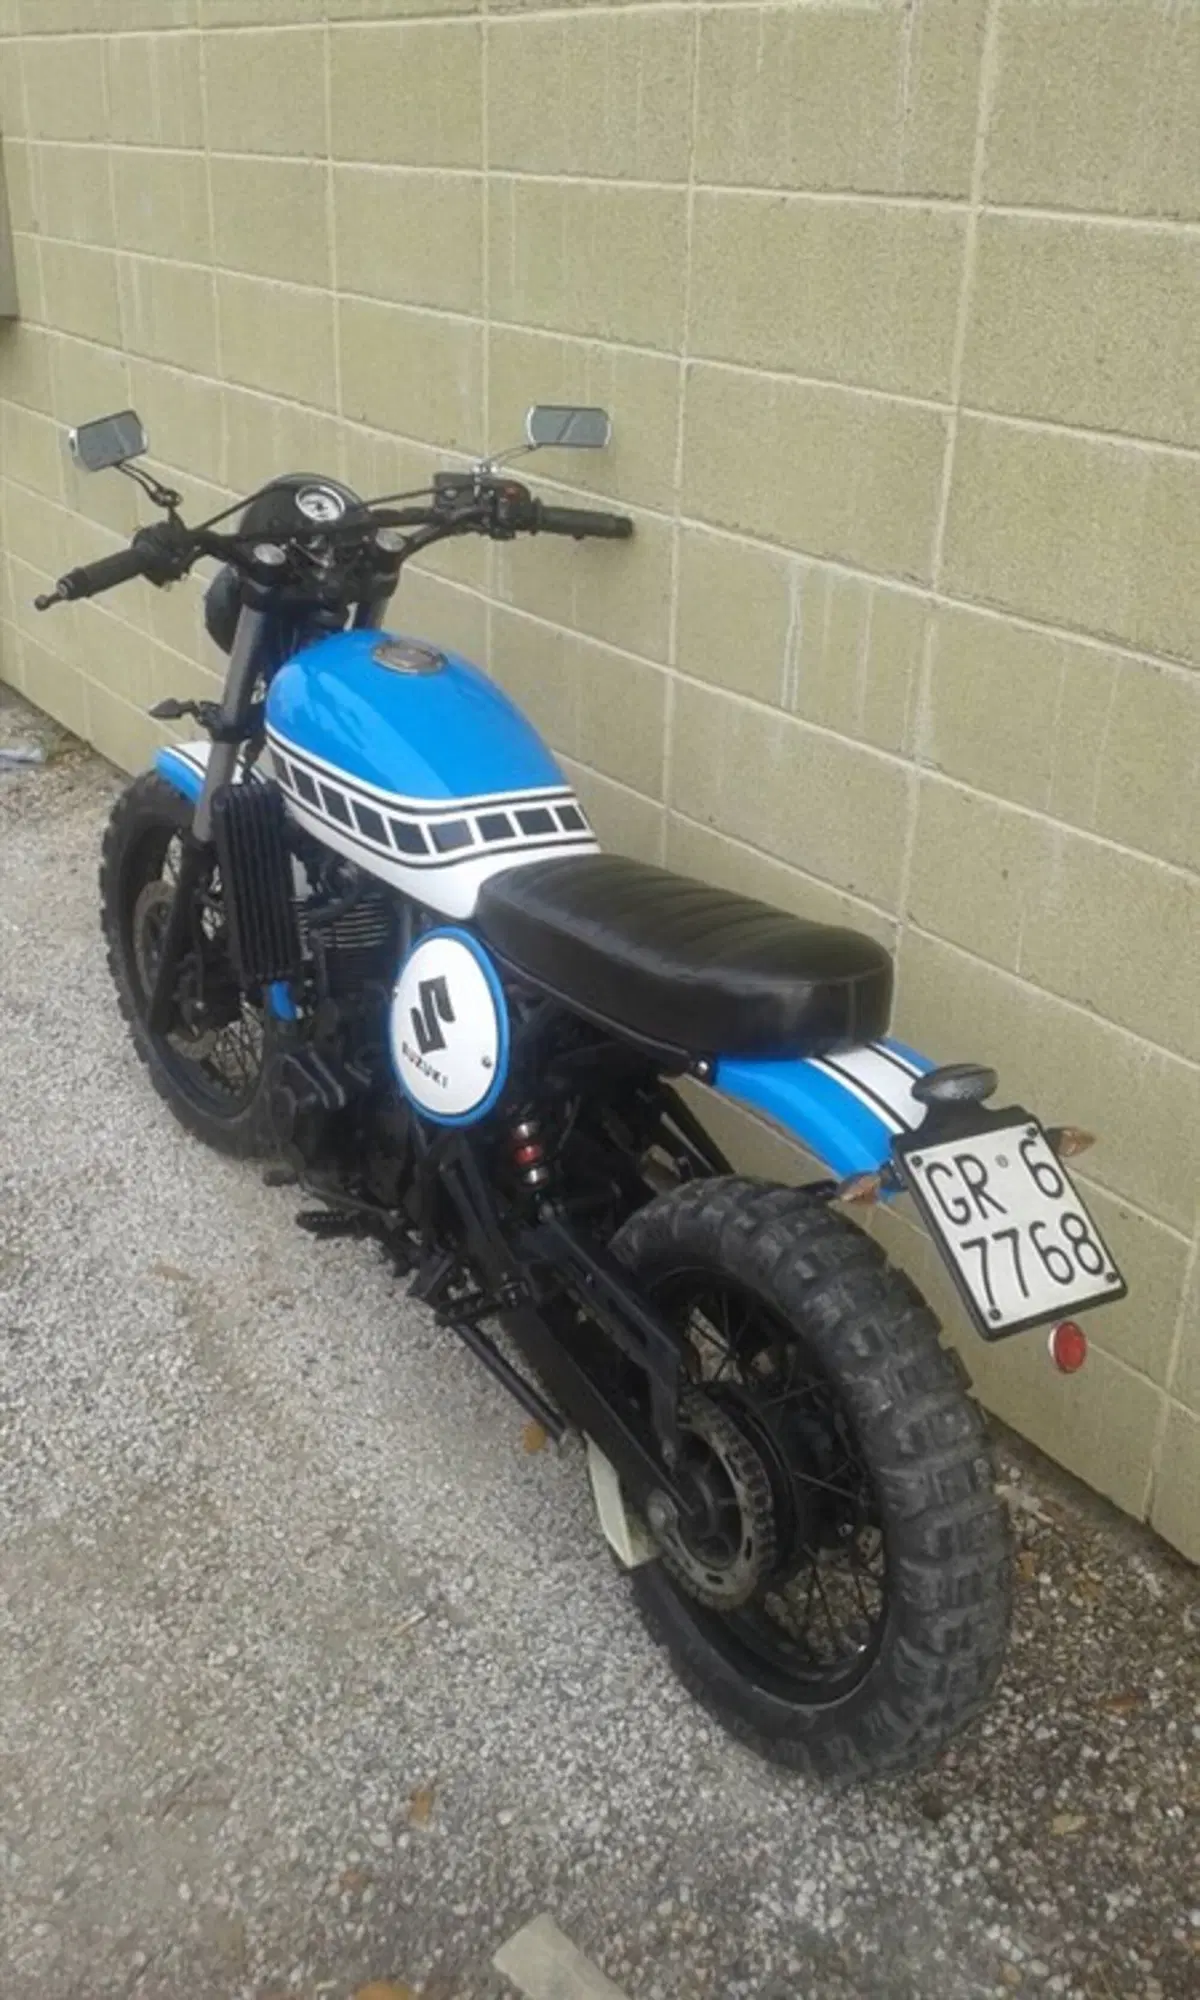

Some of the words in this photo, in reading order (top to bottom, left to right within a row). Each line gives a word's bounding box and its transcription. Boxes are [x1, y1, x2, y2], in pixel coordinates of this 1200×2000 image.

[925, 1153, 1007, 1225] GR
[1018, 1139, 1064, 1199] 6
[960, 1213, 1104, 1306] 7768
